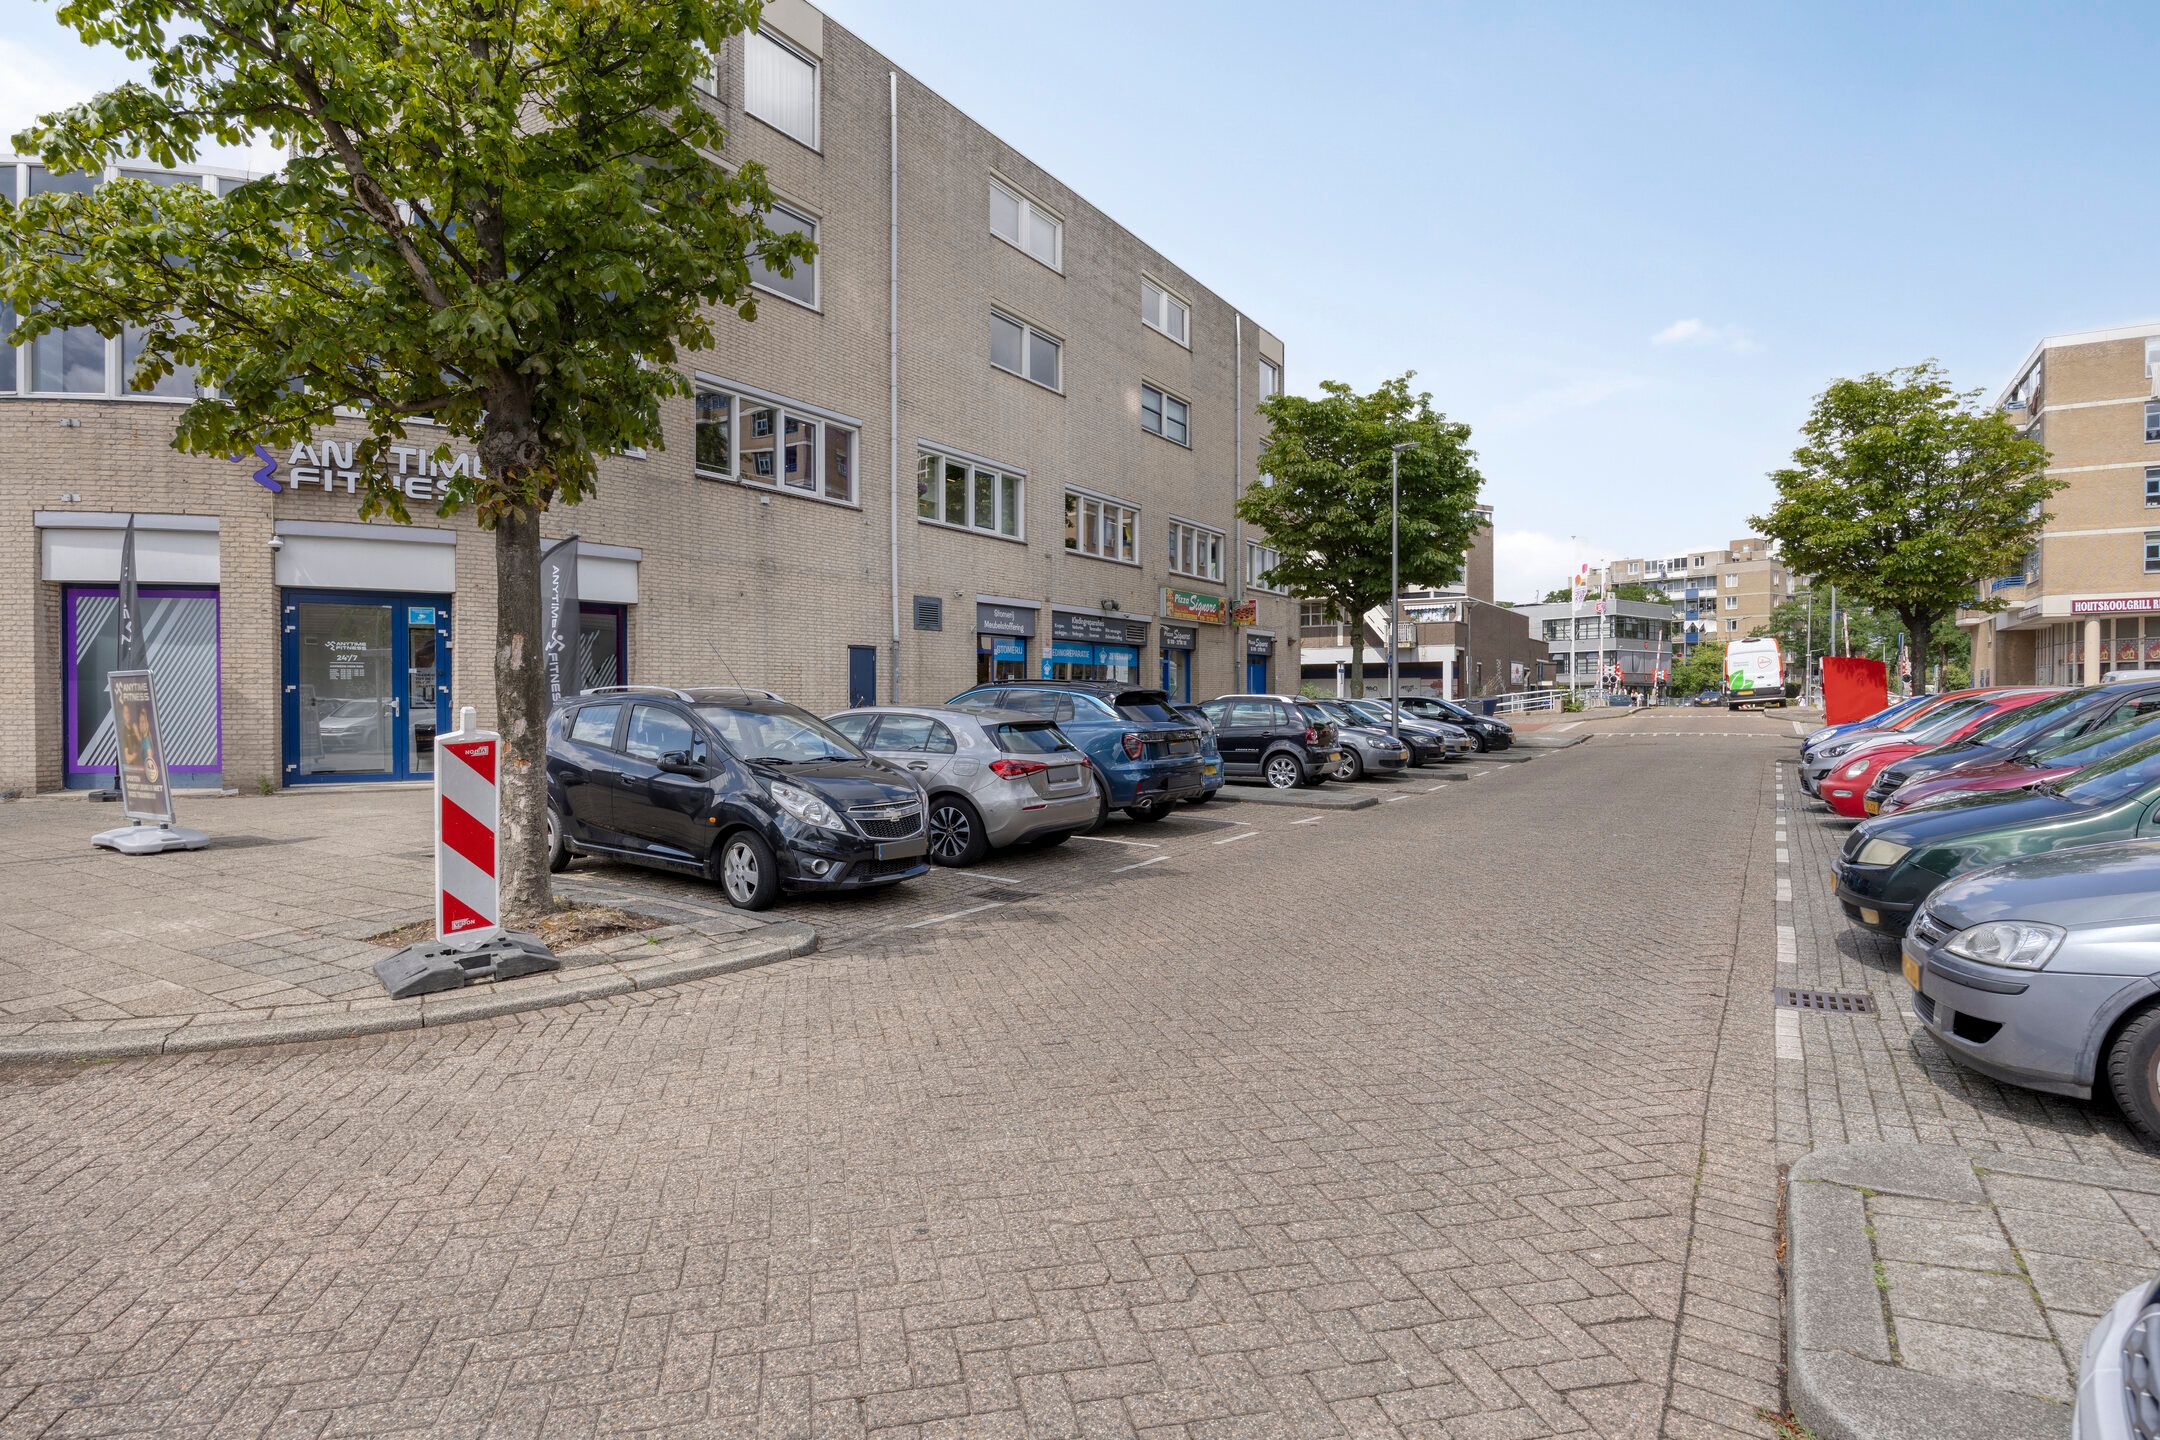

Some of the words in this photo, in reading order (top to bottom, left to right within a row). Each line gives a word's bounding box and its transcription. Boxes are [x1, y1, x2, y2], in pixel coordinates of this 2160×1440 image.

[288, 440, 488, 480] ANTIM
[552, 565, 560, 628] ANYTIME
[1189, 594, 1217, 616] Signore
[2075, 600, 2151, 612] HOUTSKOOLGRILL
[2153, 599, 2160, 609] R
[993, 609, 1015, 621] Stomerij
[983, 620, 1025, 634] Meubelstoffering
[549, 652, 561, 702] FITNES
